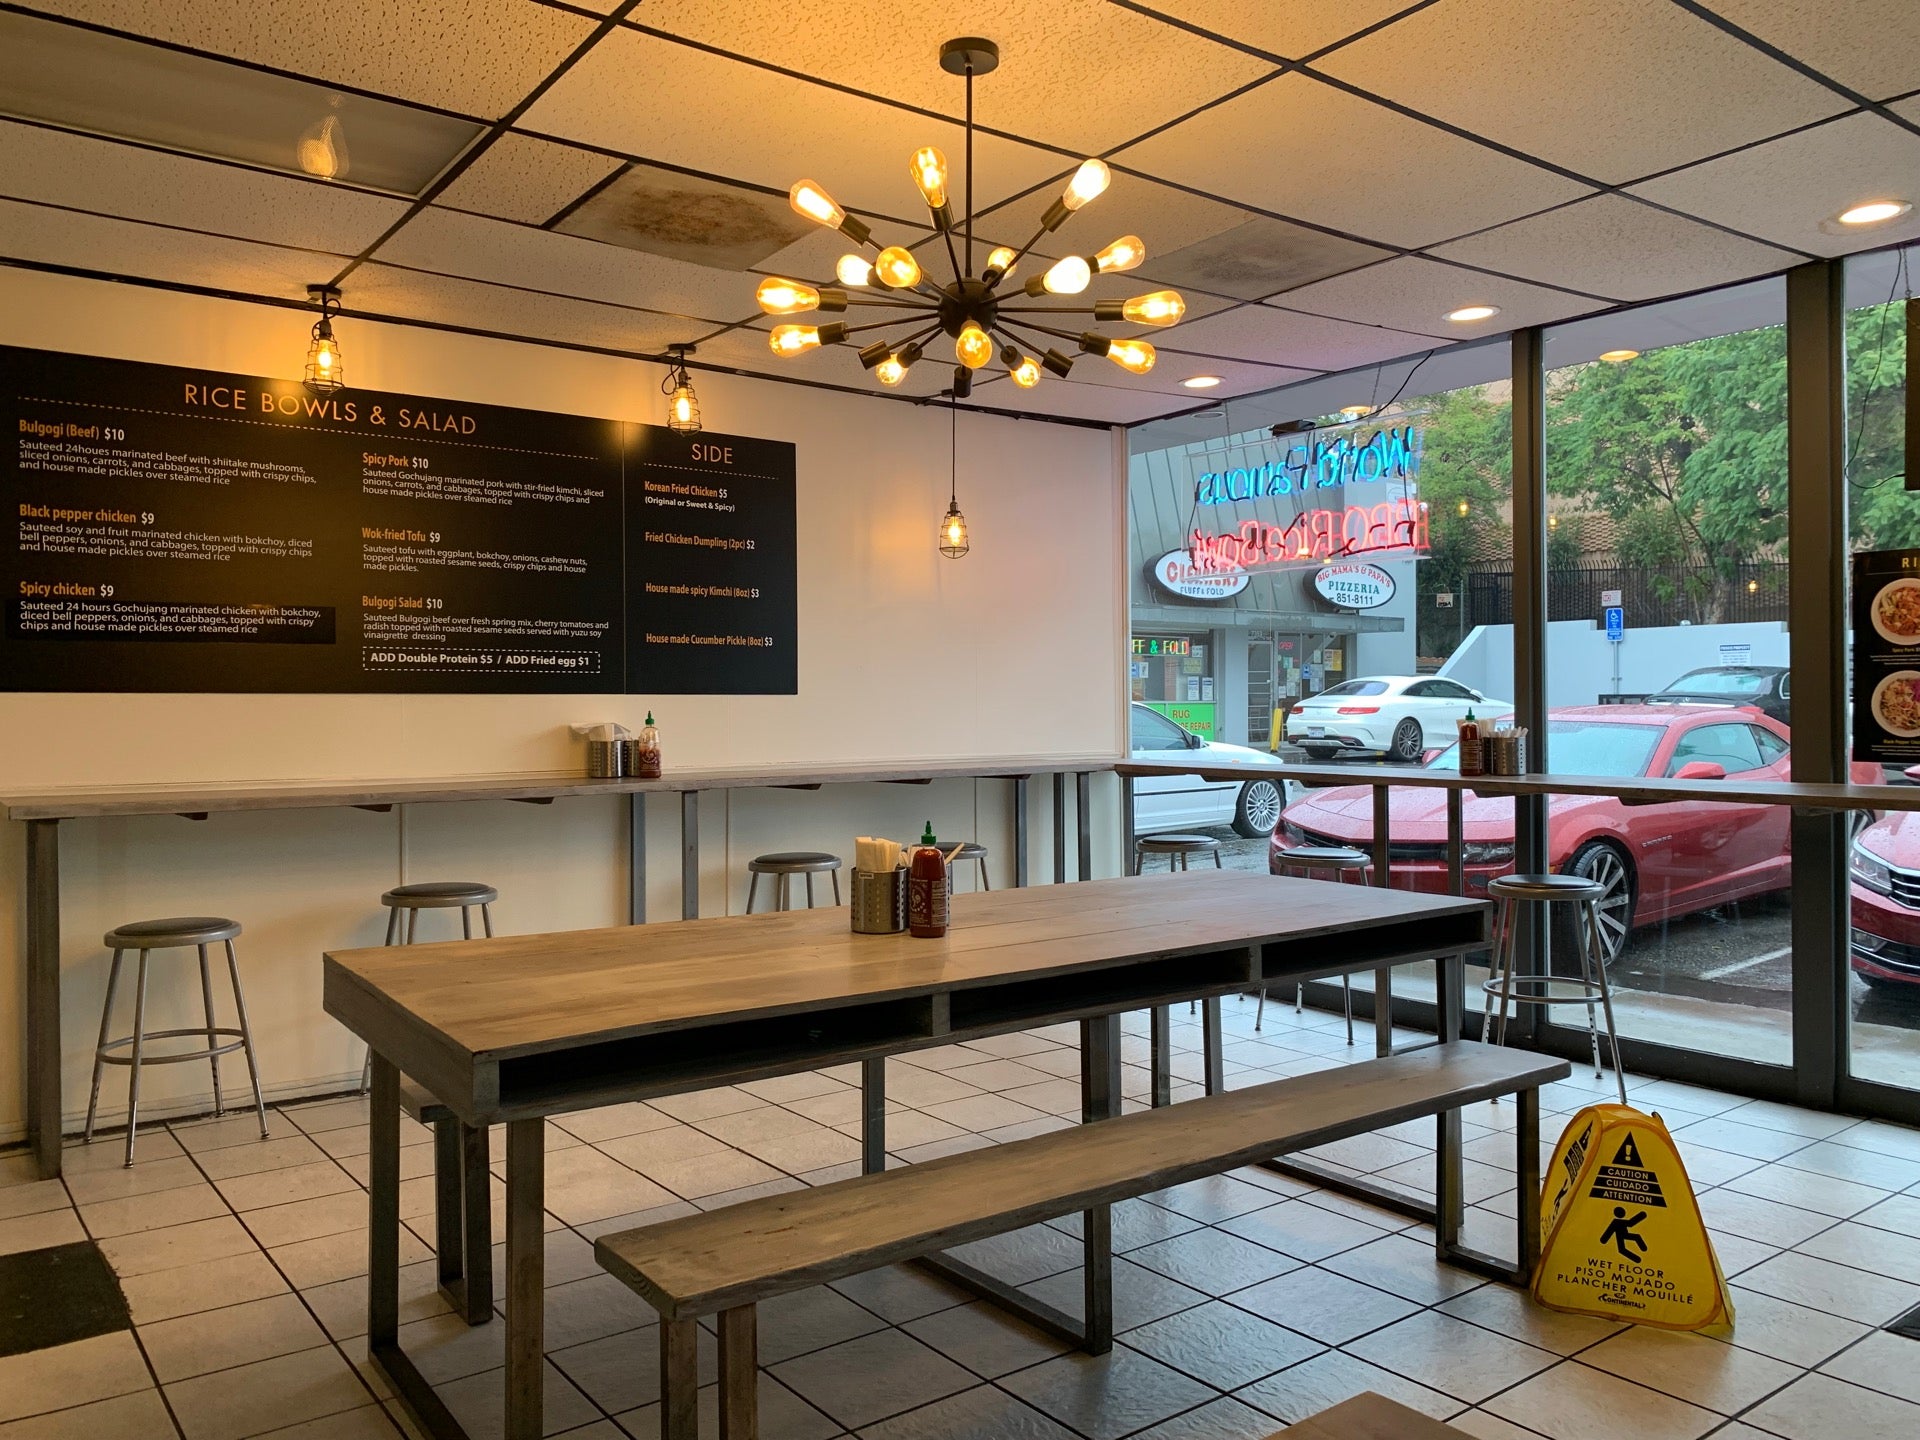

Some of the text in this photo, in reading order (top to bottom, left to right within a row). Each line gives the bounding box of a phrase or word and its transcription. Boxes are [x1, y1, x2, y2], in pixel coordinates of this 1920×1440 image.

[185, 384, 476, 434] RICE BOWLS & SALAD
[20, 419, 124, 441] Bulgogi (Beef) $10
[20, 440, 62, 452] Sauteed
[112, 449, 162, 460] marinated
[166, 452, 187, 462] beef
[189, 455, 210, 464] with
[213, 456, 248, 467] shiitake
[363, 452, 428, 469] Spicy Pork $10
[692, 444, 732, 464] SIDE
[20, 451, 50, 461] sliced
[132, 460, 150, 469] and
[204, 466, 238, 477] topped
[241, 468, 261, 477] with
[263, 470, 290, 482] crispy
[20, 460, 230, 484] and house made pickles over steamed rice
[645, 480, 727, 499] Korean Fried Chicken $5
[645, 496, 676, 507] (Original
[686, 499, 707, 508] Sweet
[708, 501, 714, 509] &
[715, 501, 735, 513] Spicy)
[20, 504, 154, 525] Black pepper chicken $9
[362, 527, 440, 544] Wok-fried Tofu $9
[646, 531, 664, 542] Fried
[665, 533, 693, 544] Chicken
[694, 535, 728, 550] Dumpling
[747, 539, 754, 550] $2
[363, 544, 397, 554] Sauteed
[399, 547, 416, 555] tofu
[417, 548, 436, 556] with
[541, 555, 568, 564] cashew
[1317, 570, 1330, 583] BIG
[1331, 564, 1360, 577] MAMA'S
[20, 582, 114, 598] Spicy chicken $9
[646, 583, 668, 593] House
[670, 584, 690, 594] made
[690, 585, 708, 598] spicy
[709, 585, 732, 596] Kimchi
[751, 587, 759, 599] $3
[1328, 580, 1380, 595] PIZZERIA
[21, 601, 64, 610] Sauteed
[67, 602, 79, 611] 24
[82, 602, 110, 611] hours
[113, 603, 168, 615] Gochujang
[170, 605, 219, 614] marinated
[221, 606, 258, 615] chicken
[257, 606, 279, 615] with
[362, 595, 442, 610] Bulgogi Salad $10
[20, 612, 50, 620] diced
[53, 612, 72, 621] bell
[160, 614, 178, 622] and
[230, 615, 264, 626] topped
[266, 616, 286, 624] with
[288, 616, 316, 627] crispy
[20, 621, 48, 632] chips
[52, 622, 71, 630] and
[74, 622, 106, 631] house
[108, 622, 136, 631] made
[139, 623, 173, 633] pickles
[199, 624, 239, 632] steamed
[241, 624, 258, 632] rice
[364, 632, 446, 642] vinaigrette dressing
[646, 633, 669, 643] House
[670, 634, 690, 644] made
[691, 634, 726, 645] Cucumber
[727, 635, 746, 645] Pickle
[765, 636, 772, 647] $3
[1150, 640, 1158, 654] &
[1163, 640, 1189, 655] FOLD
[371, 653, 588, 668] ADD Double Protein $5 / ADD Fried egg $1
[1172, 709, 1190, 718] RUG
[1190, 722, 1211, 730] REPAIR
[1608, 1168, 1649, 1180] CAUTION
[1606, 1179, 1650, 1191] CUIDADO
[1602, 1190, 1652, 1204] ATTENTION
[1588, 1258, 1664, 1278] WET FLOOR
[1576, 1266, 1675, 1290] PISO MOJADO
[1558, 1274, 1694, 1304] PLANCHER MOUILLÉ
